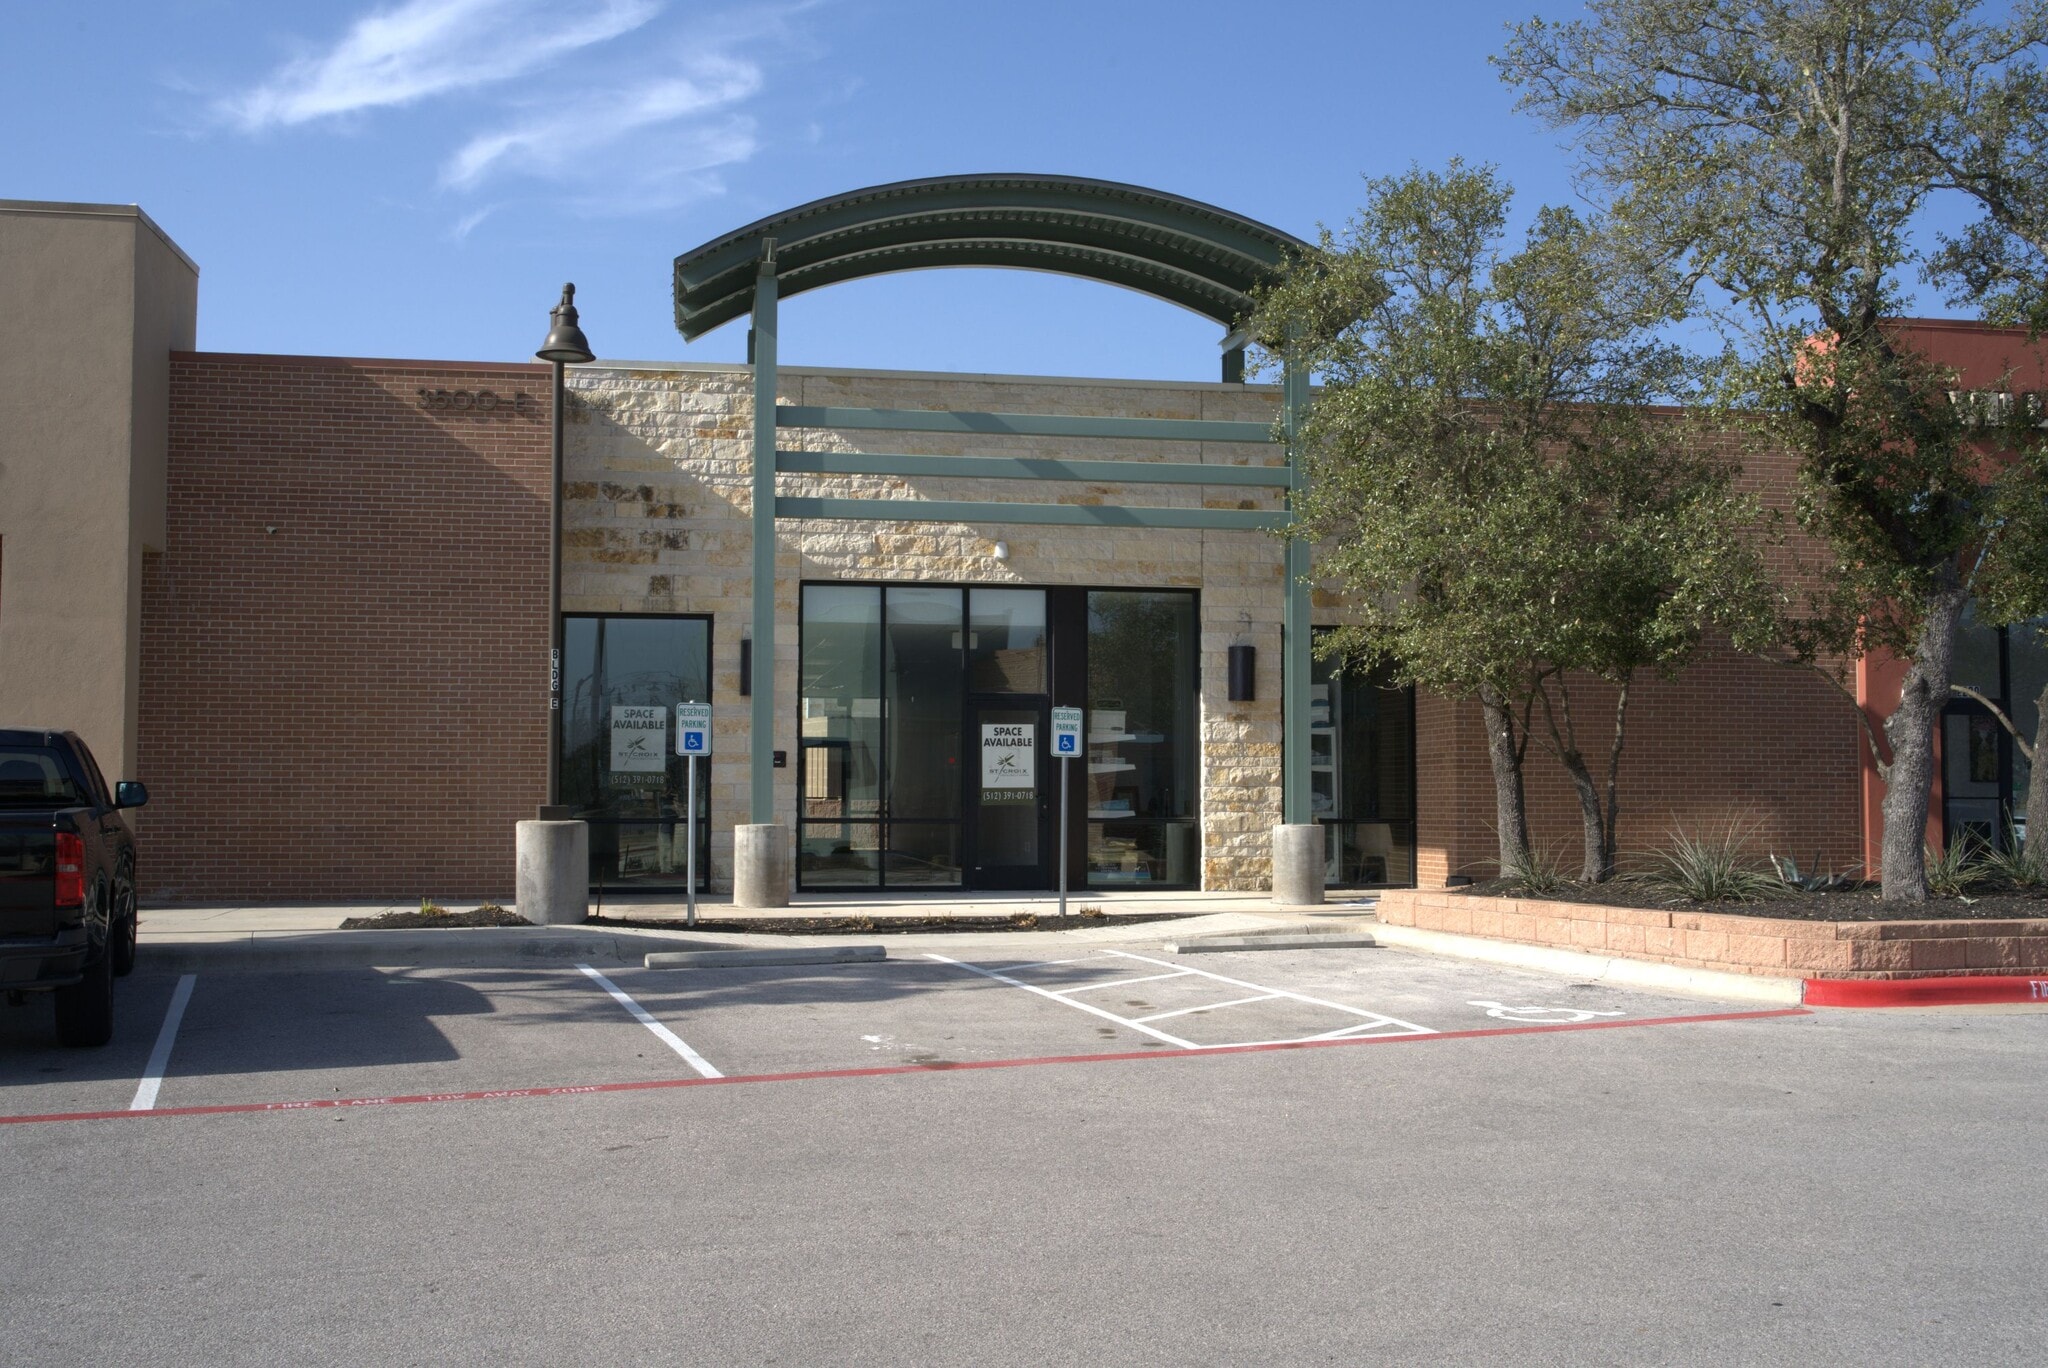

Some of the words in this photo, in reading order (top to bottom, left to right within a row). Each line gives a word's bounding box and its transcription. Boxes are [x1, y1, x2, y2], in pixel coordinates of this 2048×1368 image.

[624, 709, 655, 719] SPACE
[679, 707, 709, 717] RESERVED
[1054, 712, 1081, 721] RESERVED
[613, 720, 665, 730] AVAILABLE
[681, 720, 707, 729] PARKING
[1055, 723, 1078, 732] PARKING
[993, 727, 1023, 737] SPACE
[983, 738, 1033, 748] AVAILABLE
[983, 791, 1002, 801] (512)
[1003, 791, 1034, 800] 391-0718
